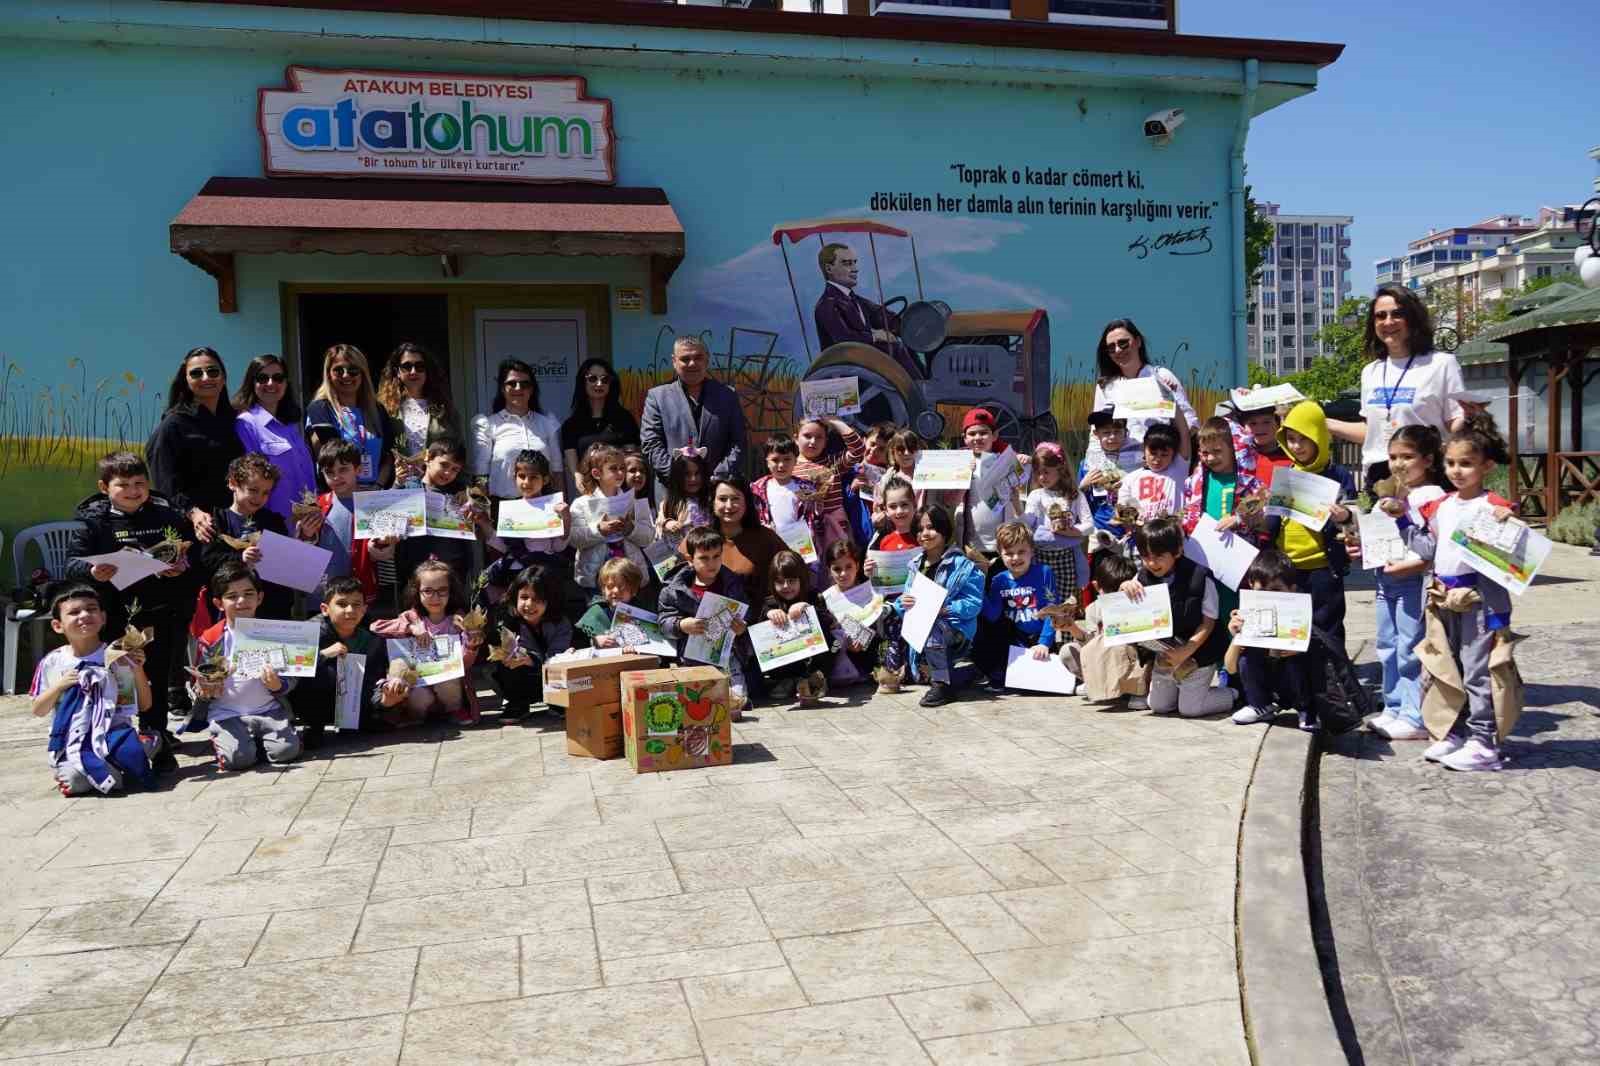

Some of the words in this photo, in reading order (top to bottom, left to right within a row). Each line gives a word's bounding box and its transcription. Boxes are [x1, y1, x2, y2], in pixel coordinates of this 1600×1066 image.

[343, 79, 424, 95] ATAKUM
[281, 98, 592, 156] atatohum
[384, 159, 418, 169] tohum
[422, 158, 437, 169] bir
[440, 159, 473, 173] ülkeyi
[1012, 170, 1020, 184] o
[1025, 166, 1068, 187] kadar
[1072, 169, 1124, 189] cömert
[870, 192, 932, 212] dökülen
[937, 193, 962, 212] her
[967, 193, 1012, 213] damla
[1017, 196, 1044, 214] alın
[1048, 197, 1097, 217] terinin
[1101, 198, 1172, 222] karşılığını
